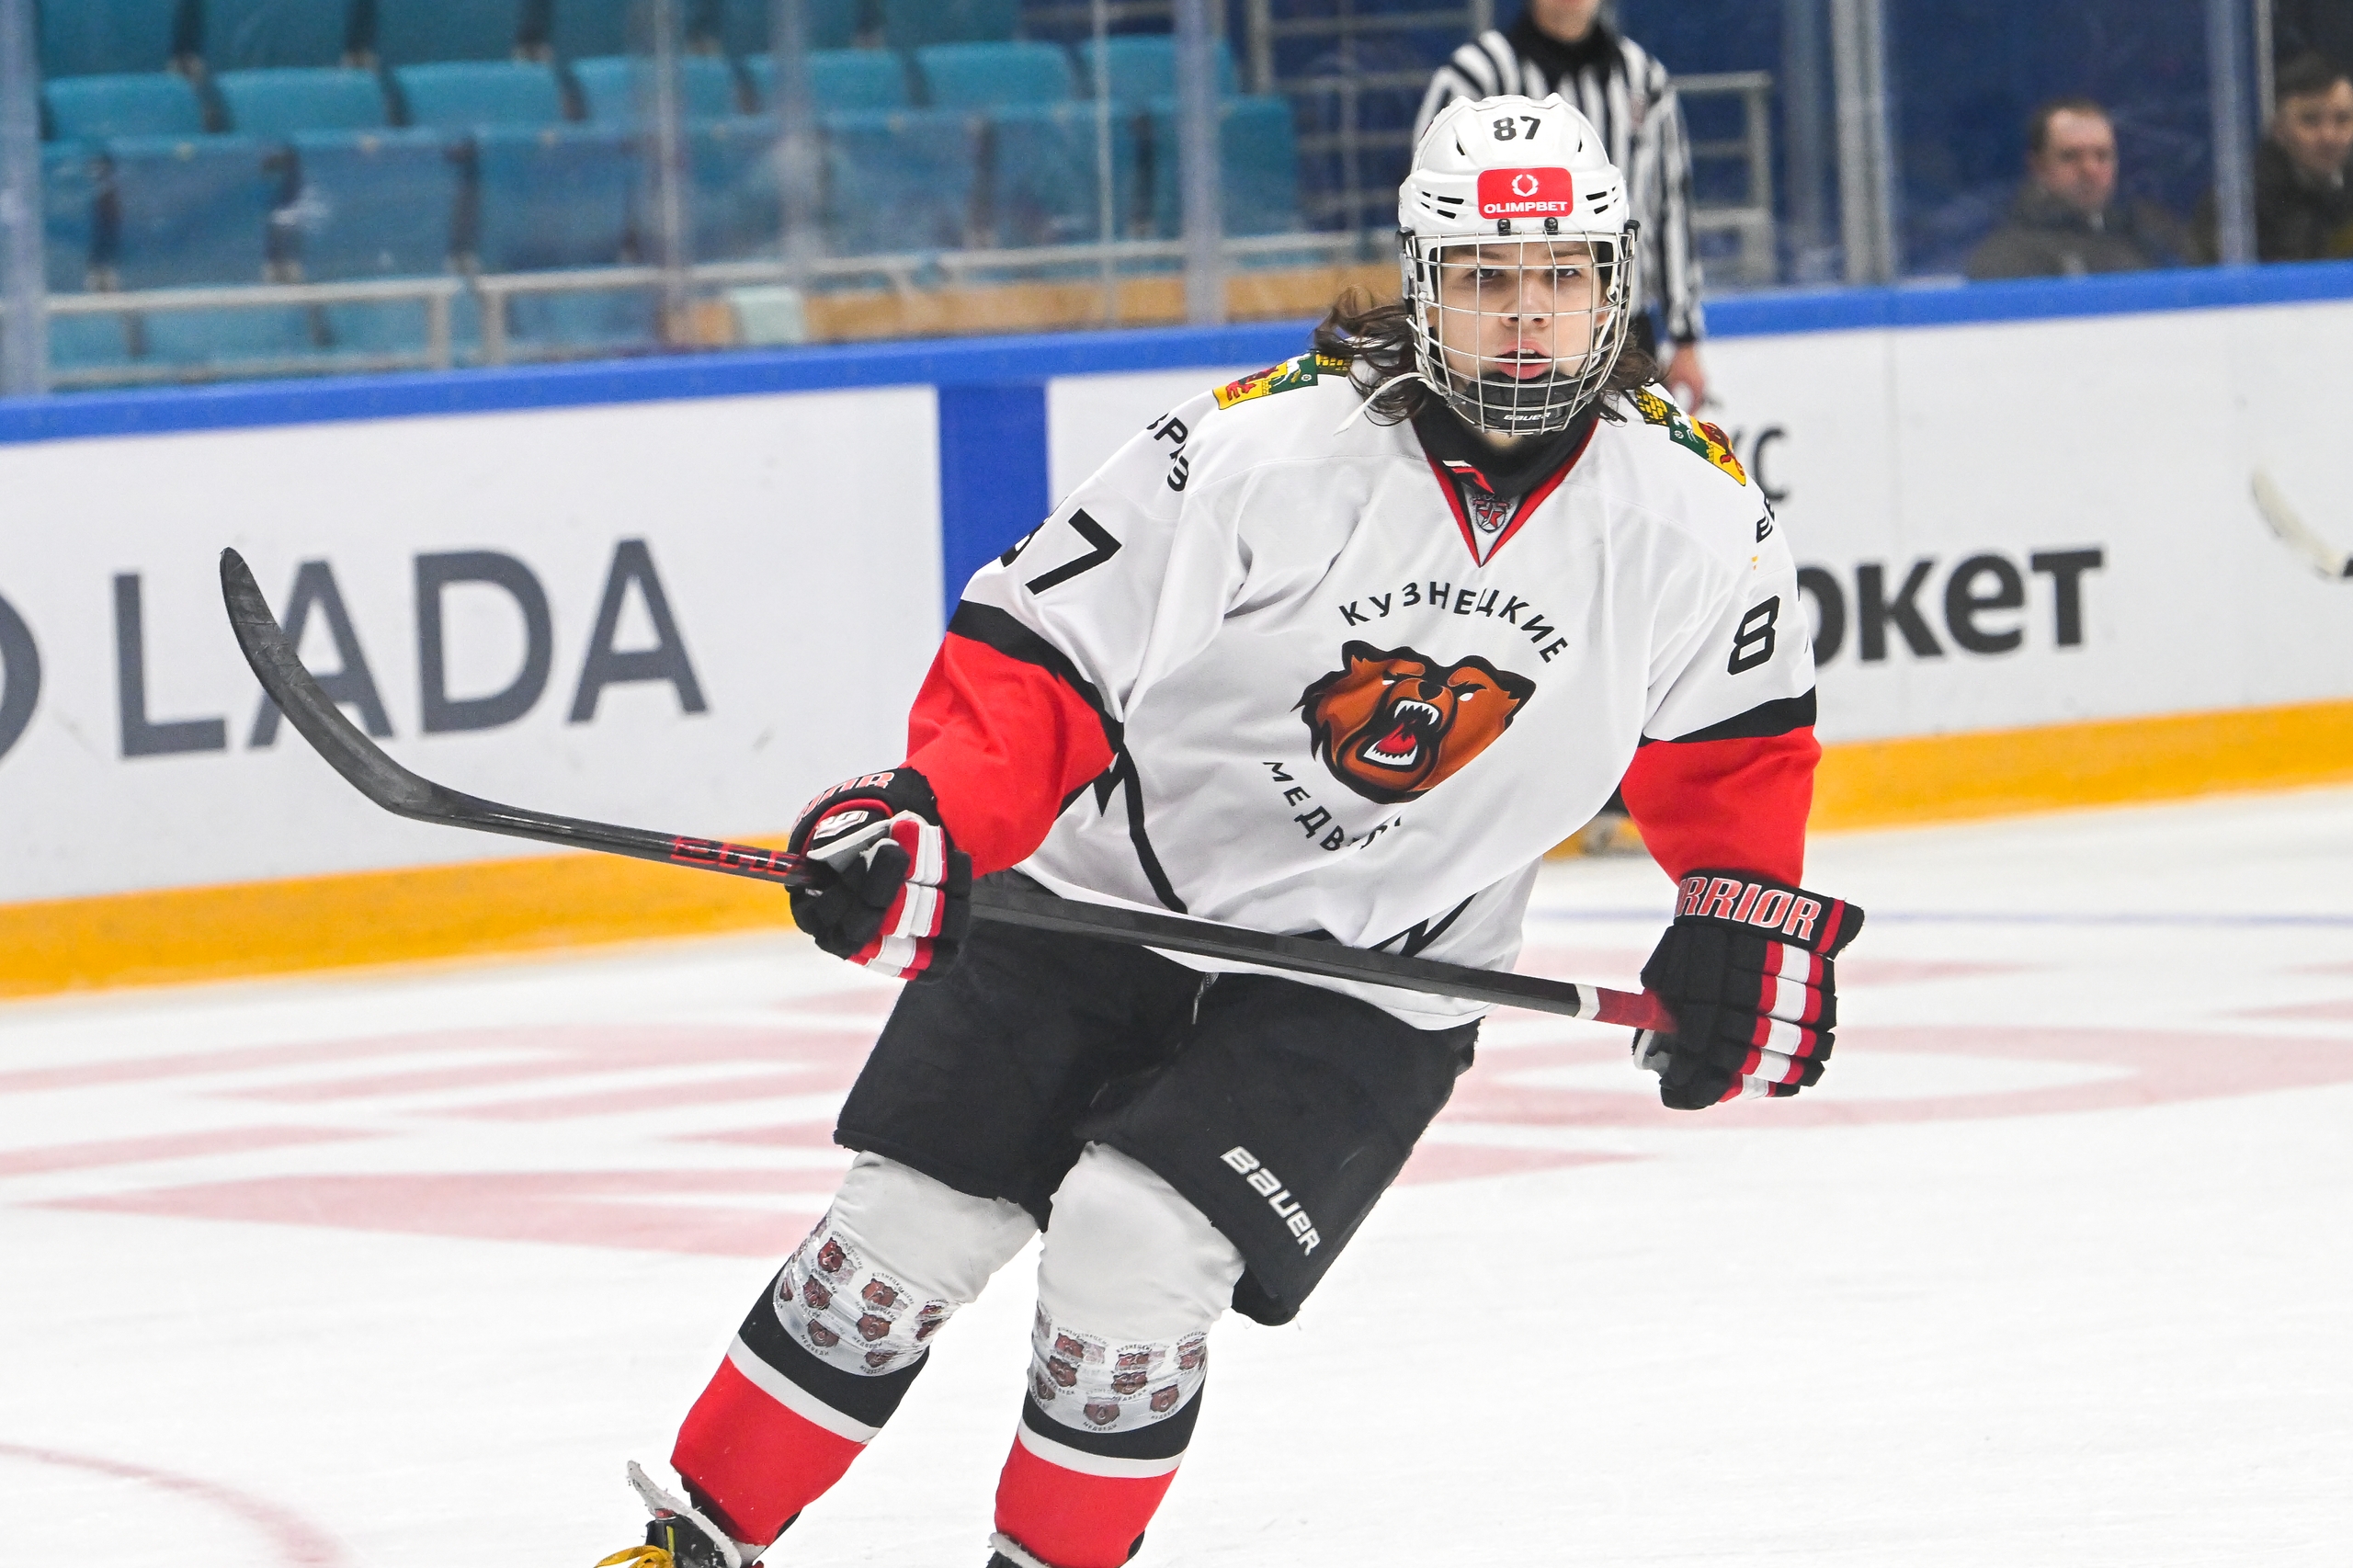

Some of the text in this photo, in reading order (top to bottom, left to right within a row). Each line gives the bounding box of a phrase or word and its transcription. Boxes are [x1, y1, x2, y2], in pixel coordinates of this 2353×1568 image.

[1493, 115, 1541, 142] 87
[1483, 201, 1568, 214] OLIMPBET
[114, 538, 710, 759] LADA
[1338, 581, 1569, 664] КУЗНЕЦКИЕ
[1727, 595, 1780, 676] 8
[1676, 876, 1823, 941] RRIOR
